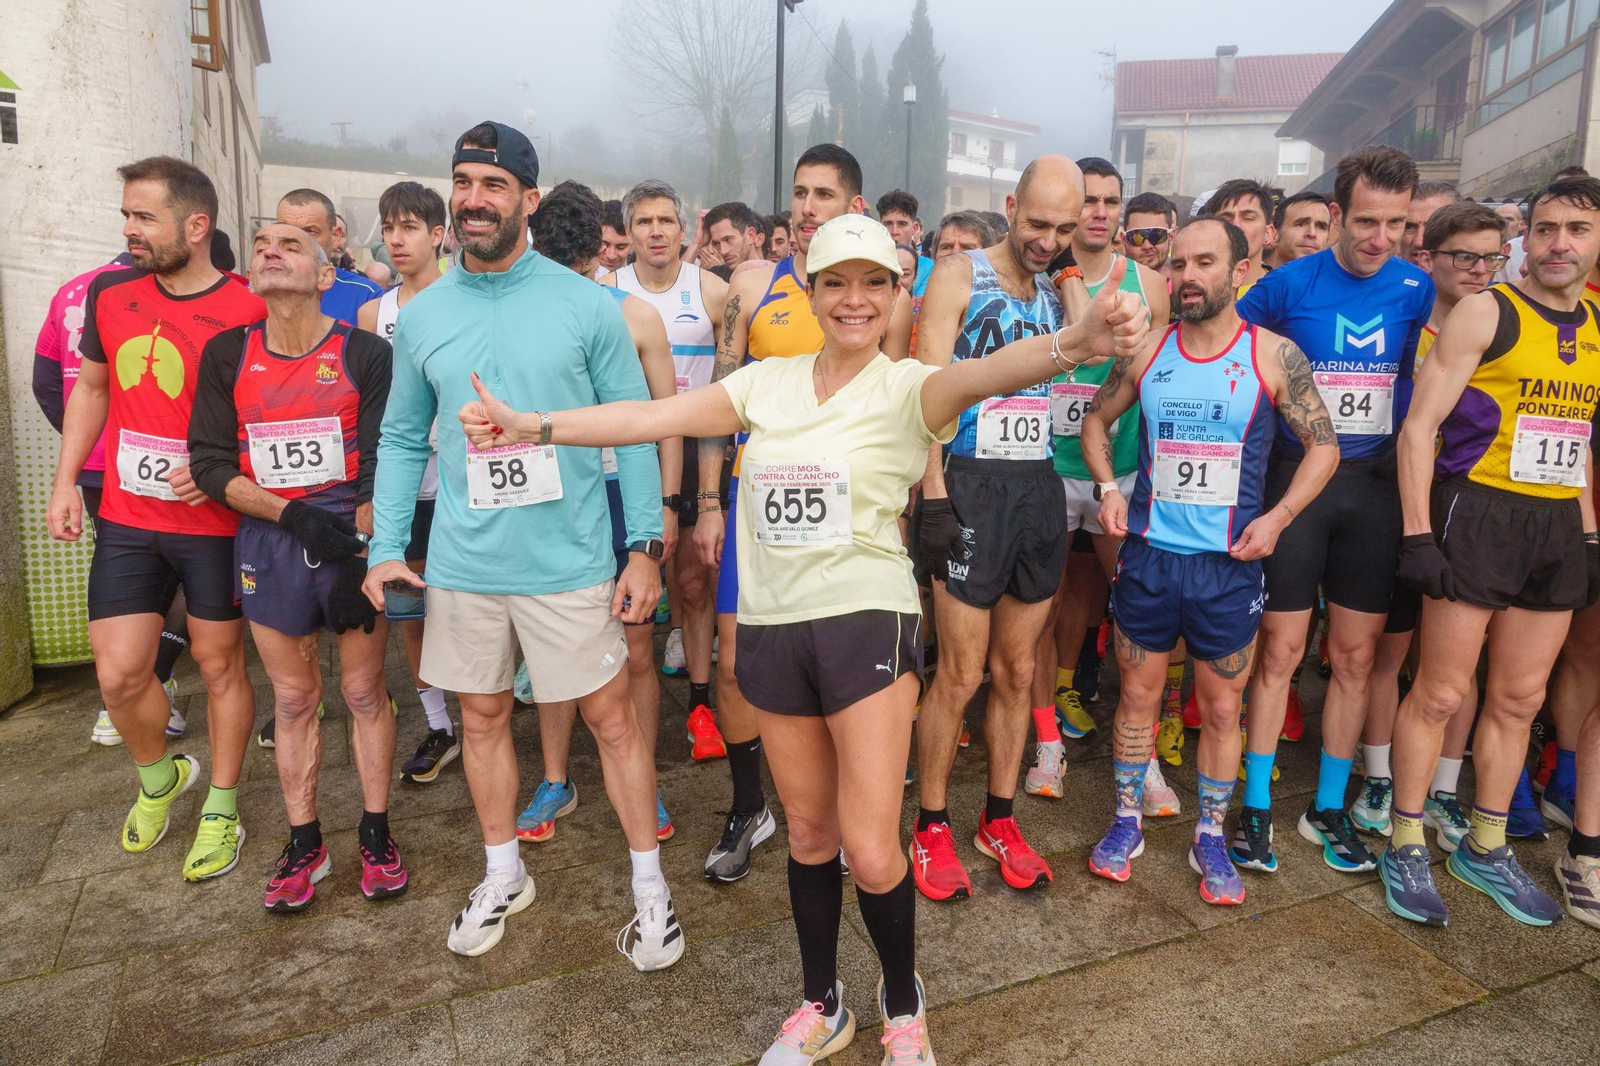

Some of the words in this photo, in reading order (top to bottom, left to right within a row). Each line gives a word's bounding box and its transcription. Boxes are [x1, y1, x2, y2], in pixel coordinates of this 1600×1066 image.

[1310, 360, 1364, 371] MARINA
[1518, 378, 1600, 405] TANINOS
[1339, 392, 1372, 417] 84
[1515, 402, 1594, 420] PONTEAREA
[264, 421, 318, 431] CORREMOS
[297, 426, 333, 434] CANCRO
[999, 416, 1040, 442] 103
[1176, 424, 1206, 433] XUNTA
[1541, 419, 1585, 429] CORREMOS
[125, 439, 151, 449] CONTRA
[134, 435, 181, 447] CORREMOS
[1188, 434, 1224, 442] GALICIA
[508, 442, 539, 451] CANC
[1173, 443, 1222, 451] CORREMOS
[269, 441, 323, 470] 153
[1536, 438, 1581, 468] 115
[138, 455, 170, 482] 62
[488, 458, 527, 489] 58
[1178, 462, 1208, 487] 91
[797, 472, 840, 480] CANCRO
[765, 488, 826, 524] 655
